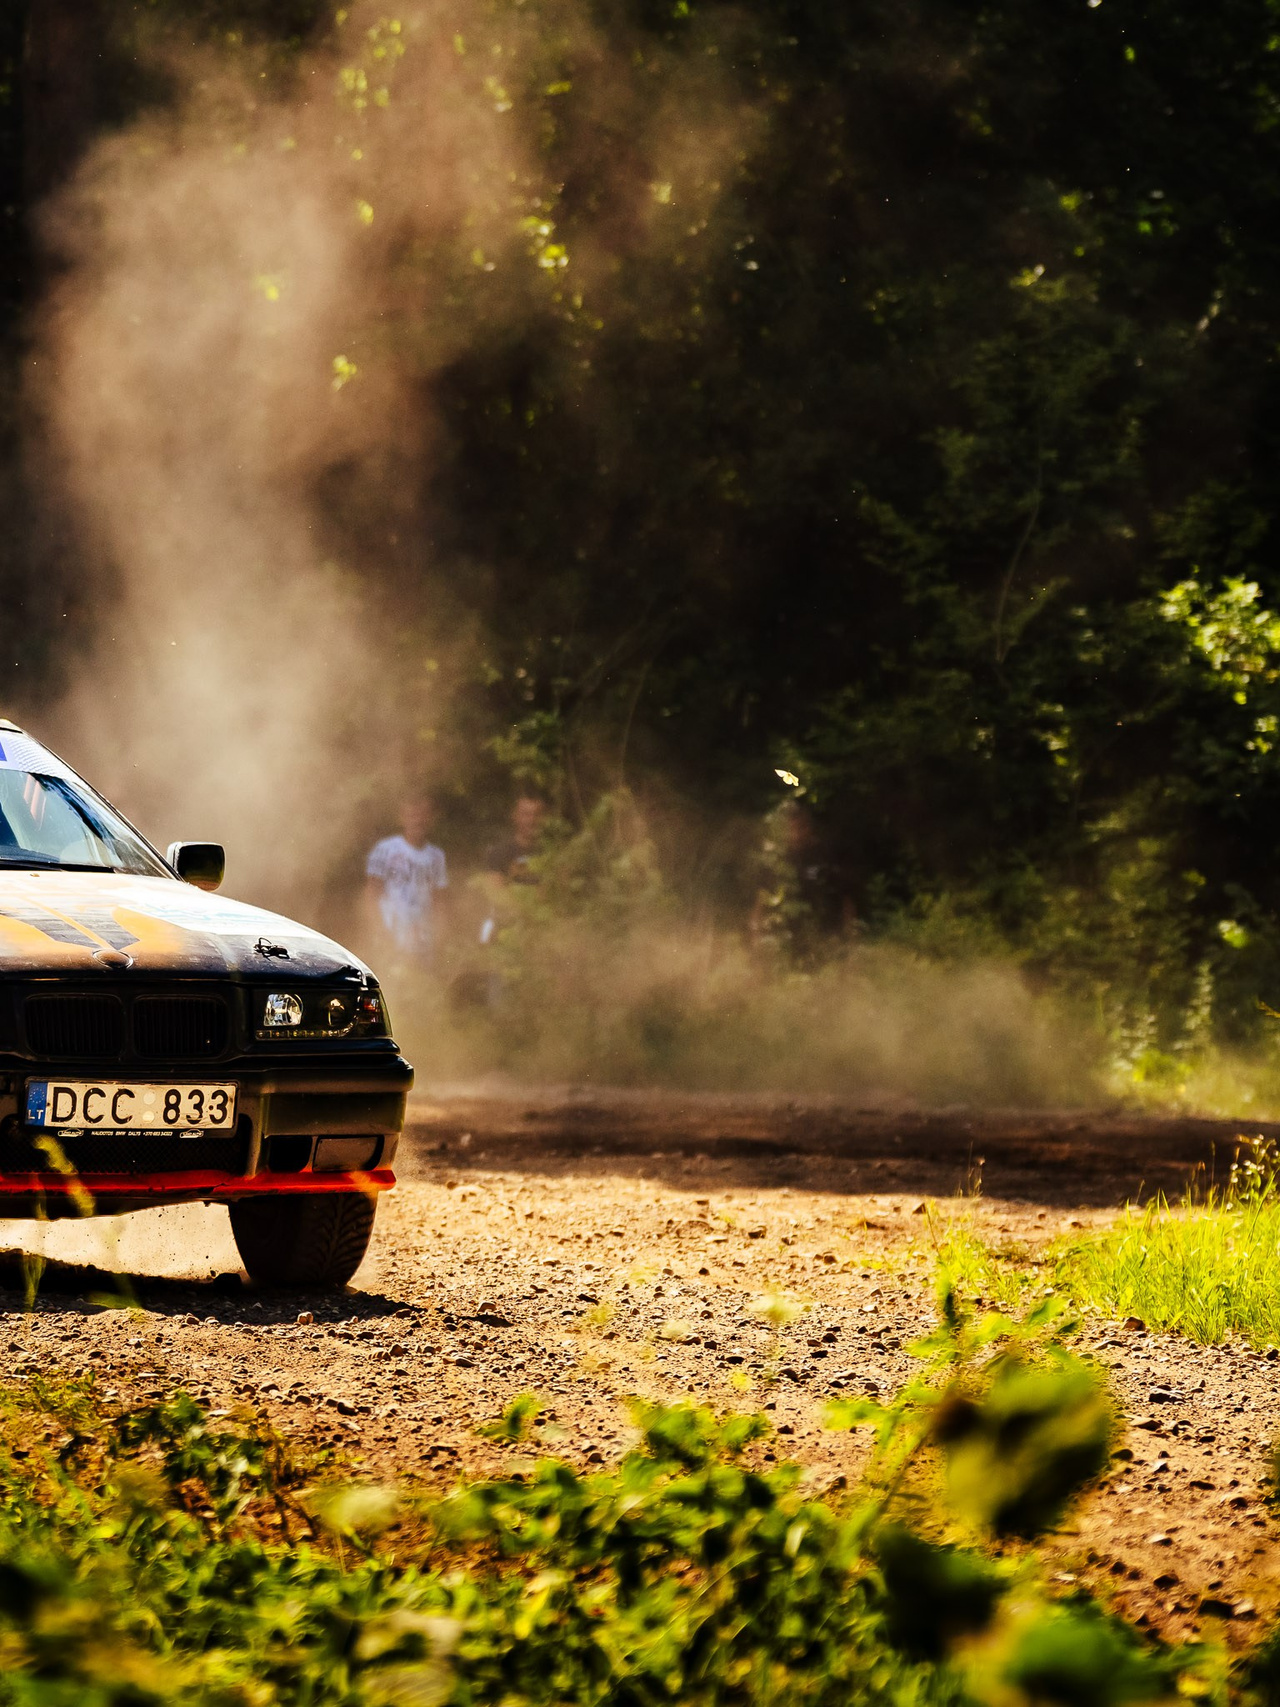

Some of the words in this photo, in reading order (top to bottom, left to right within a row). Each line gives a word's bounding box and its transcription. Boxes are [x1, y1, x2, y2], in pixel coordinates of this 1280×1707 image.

[28, 1108, 44, 1120] LT
[51, 1086, 135, 1124] DCC
[163, 1088, 228, 1125] 833
